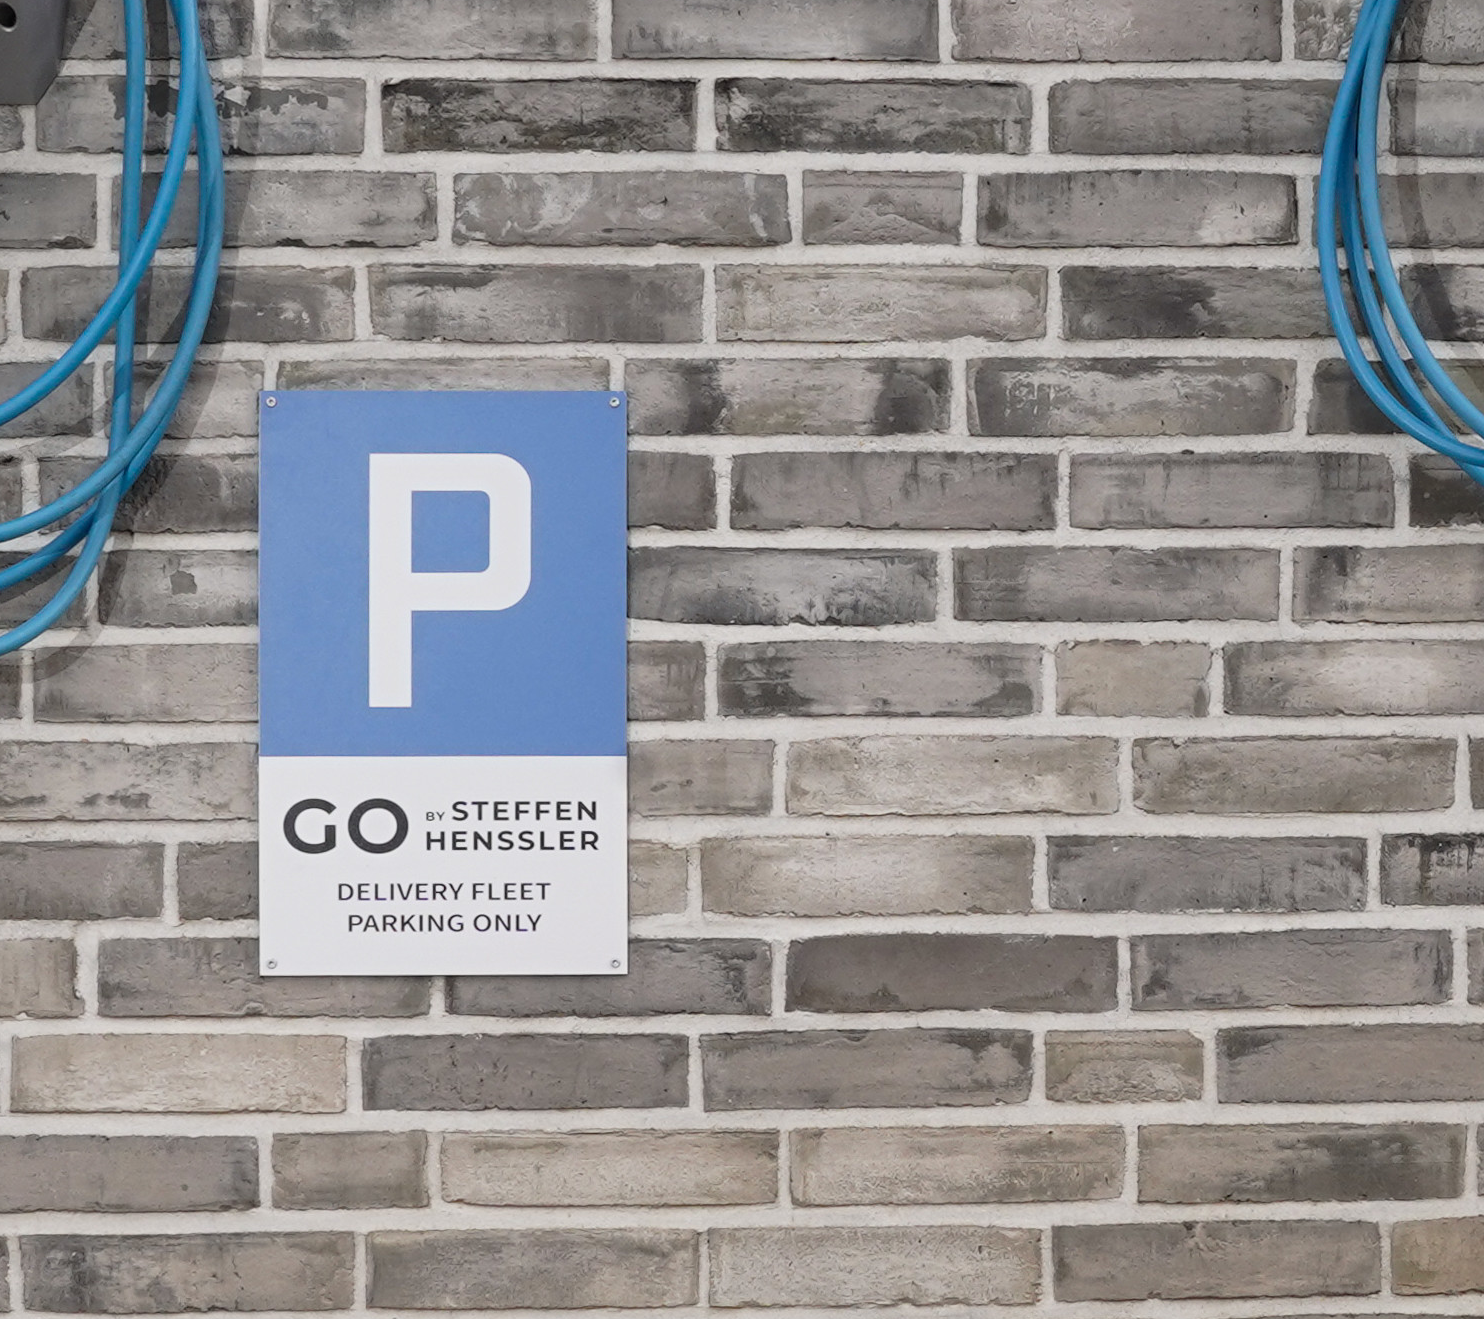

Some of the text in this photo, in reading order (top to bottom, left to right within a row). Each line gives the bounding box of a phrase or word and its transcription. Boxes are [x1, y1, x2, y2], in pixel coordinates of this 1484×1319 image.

[368, 452, 532, 707] P
[425, 800, 598, 822] BY STEFFEN
[283, 798, 409, 854] GO
[425, 830, 600, 851] HENSSLER
[337, 882, 552, 901] DELIVERY FLEET
[347, 913, 542, 932] PARKING ONLY
